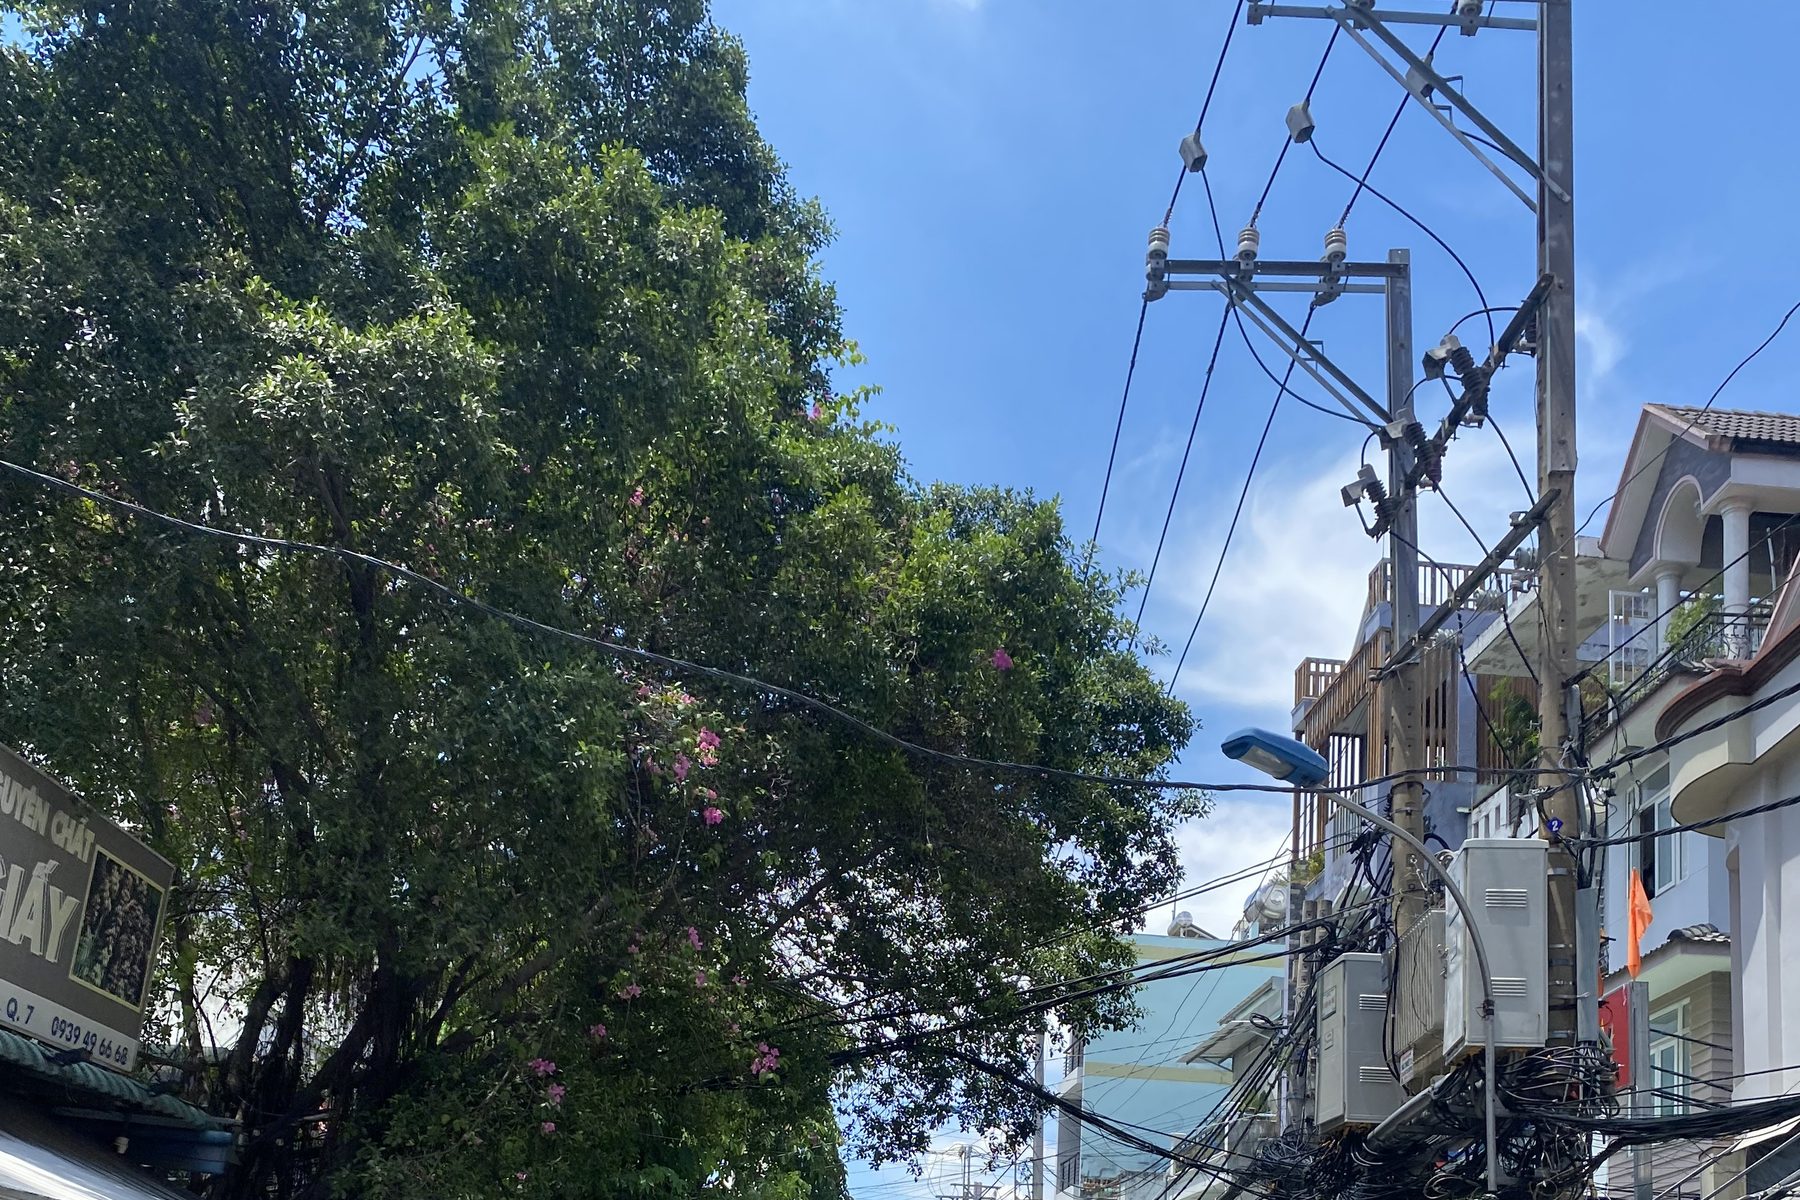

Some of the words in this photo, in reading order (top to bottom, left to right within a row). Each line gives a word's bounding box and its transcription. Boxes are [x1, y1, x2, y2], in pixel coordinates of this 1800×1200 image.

[0, 771, 51, 836] UYÊN
[1551, 820, 1559, 832] 2
[25, 1005, 35, 1024] 7
[51, 1016, 81, 1044] 0939
[83, 1030, 98, 1055] 49
[99, 1038, 113, 1059] 66
